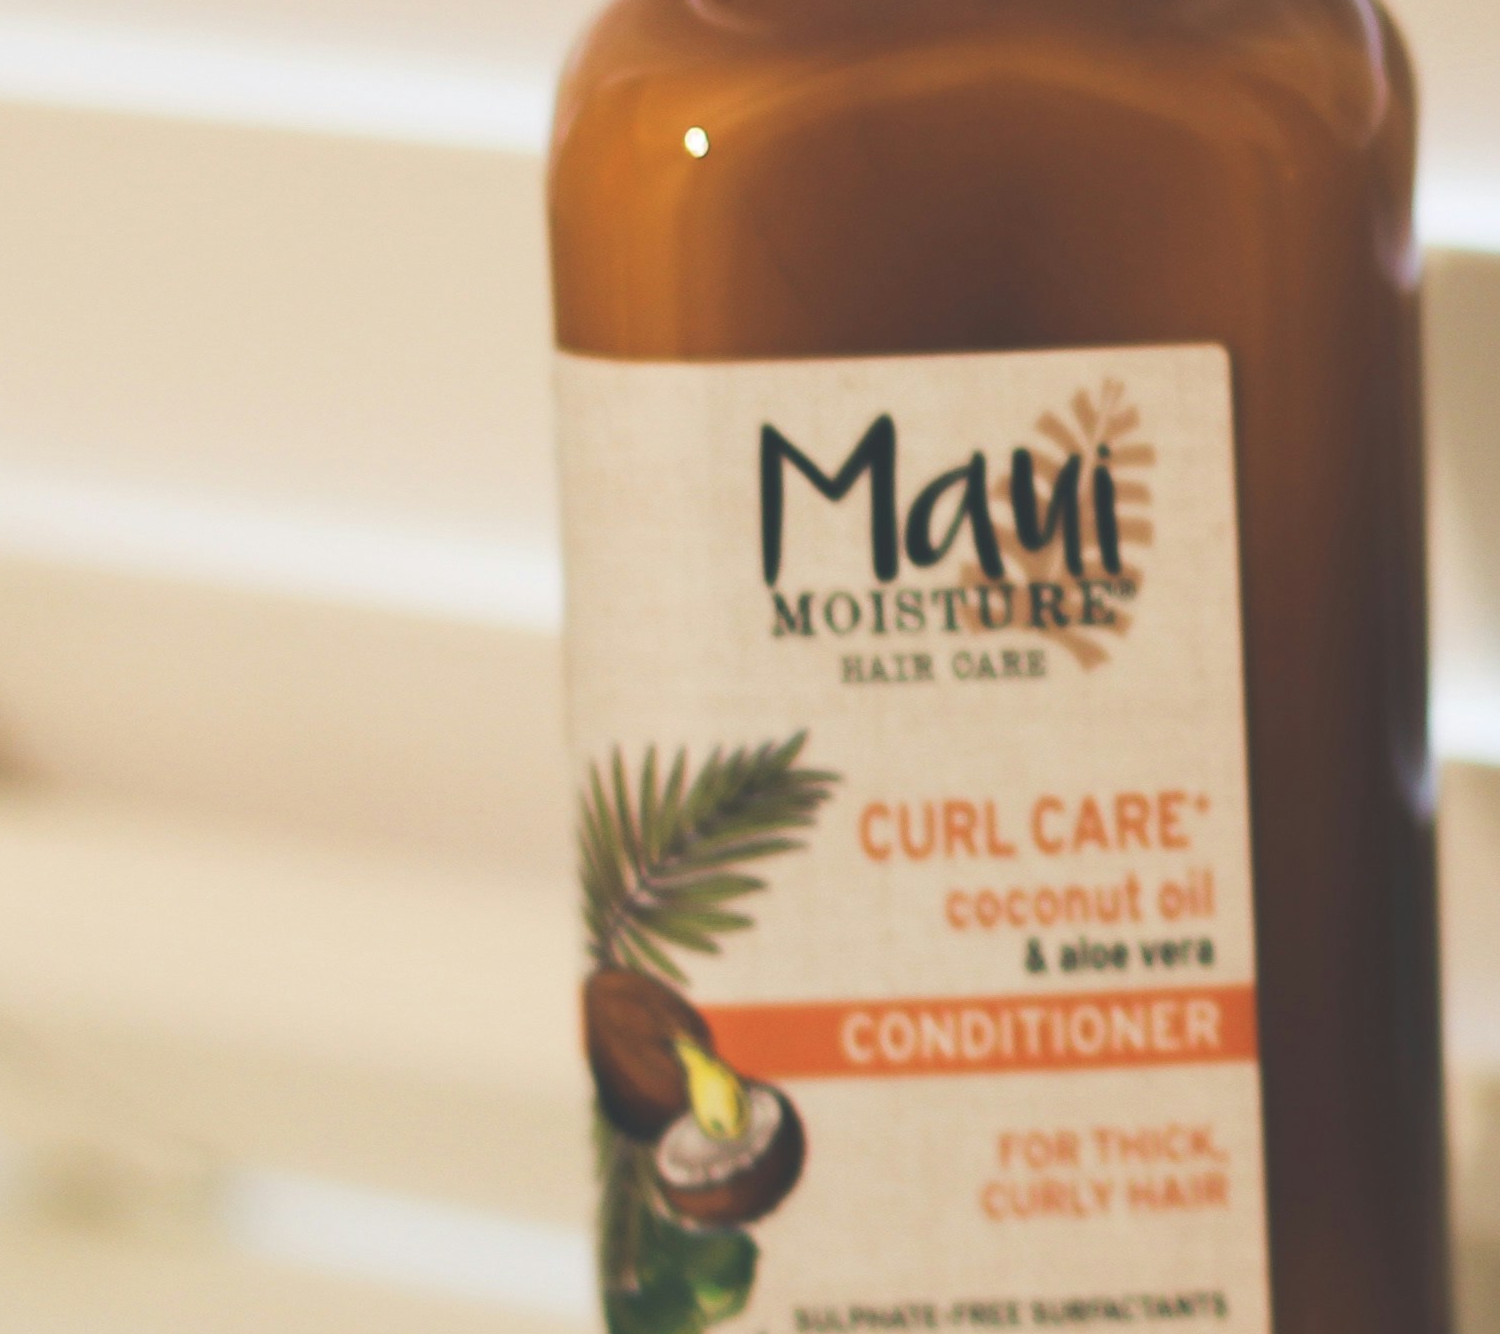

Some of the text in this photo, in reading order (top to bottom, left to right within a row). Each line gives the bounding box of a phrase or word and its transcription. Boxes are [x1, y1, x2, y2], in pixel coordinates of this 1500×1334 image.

[759, 412, 1123, 587] Maui
[841, 649, 1047, 684] HAIR CARE
[859, 799, 1017, 861] CURL
[945, 871, 1216, 931] coconut oil
[1025, 936, 1214, 974] & aloe vera
[841, 1000, 1221, 1064] CONDITIONER
[999, 1122, 1229, 1170] FOR THICK,
[982, 1172, 1229, 1222] CURLY HAIR
[793, 1292, 1229, 1334] SULPHATE-FREE SURFACTANTS
